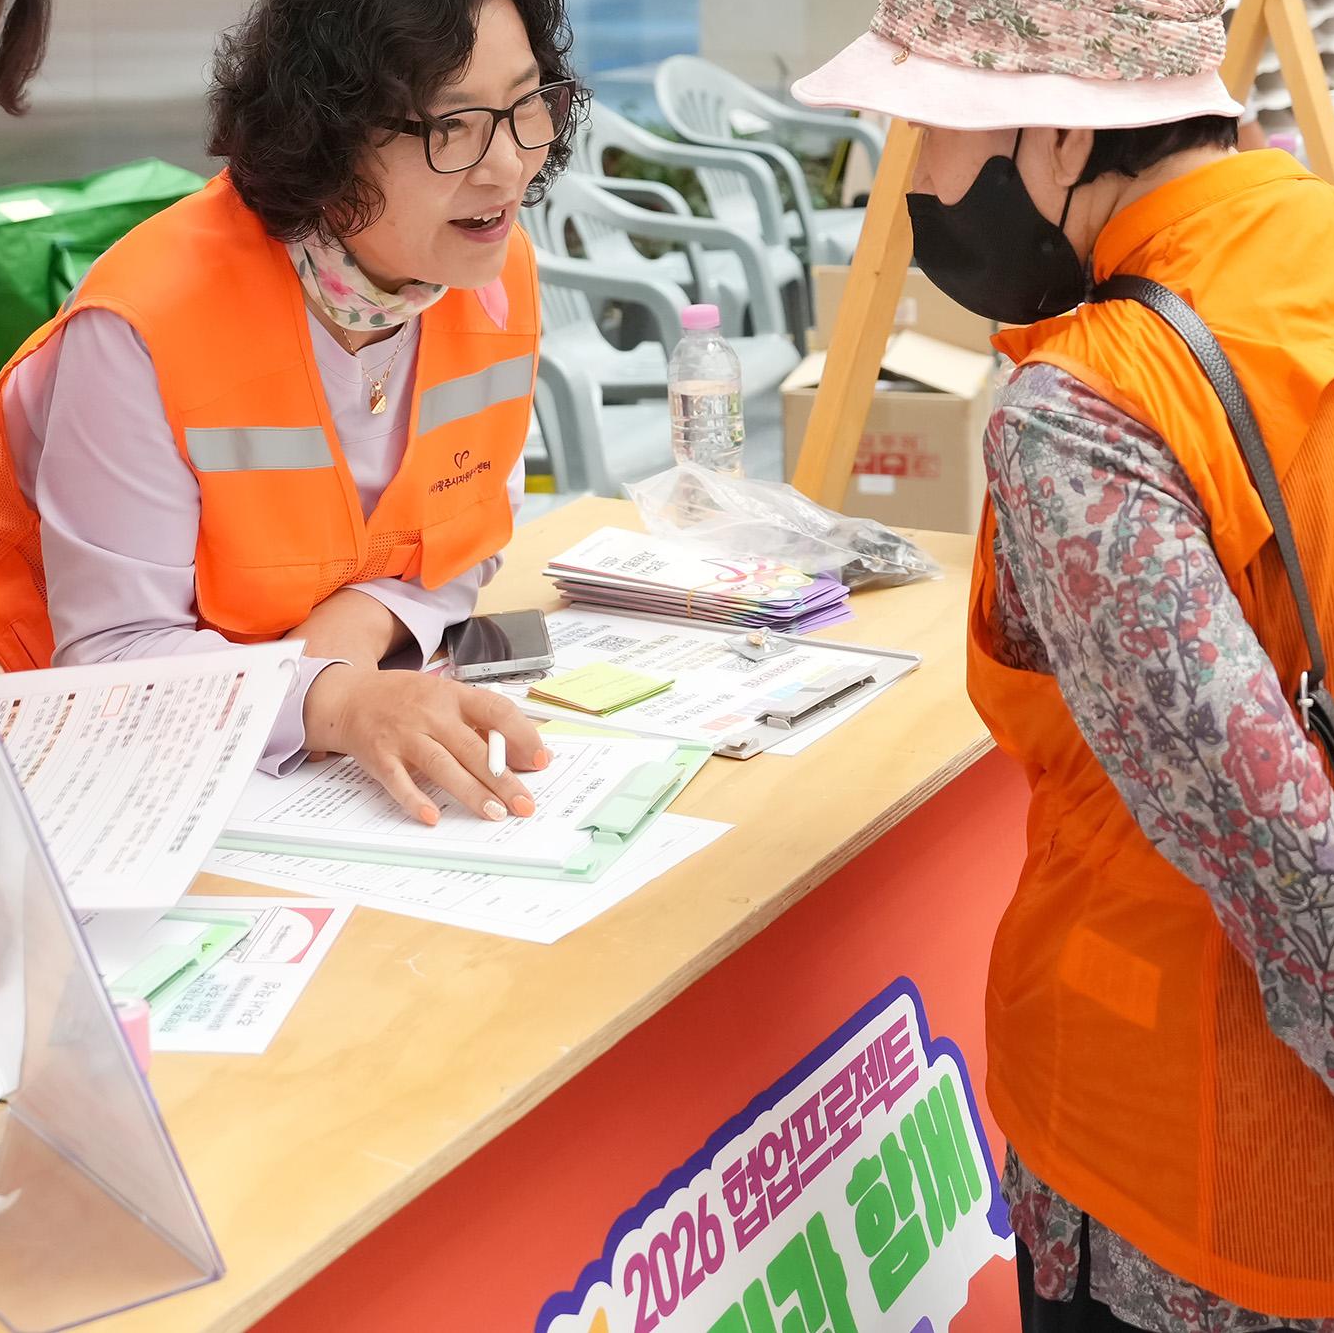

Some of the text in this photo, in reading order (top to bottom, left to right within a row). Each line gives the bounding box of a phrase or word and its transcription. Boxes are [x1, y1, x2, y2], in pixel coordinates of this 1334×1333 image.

[624, 1194, 725, 1333] 2026
[722, 1014, 919, 1253] 협업프로젝트
[846, 1073, 982, 1313] 함께
